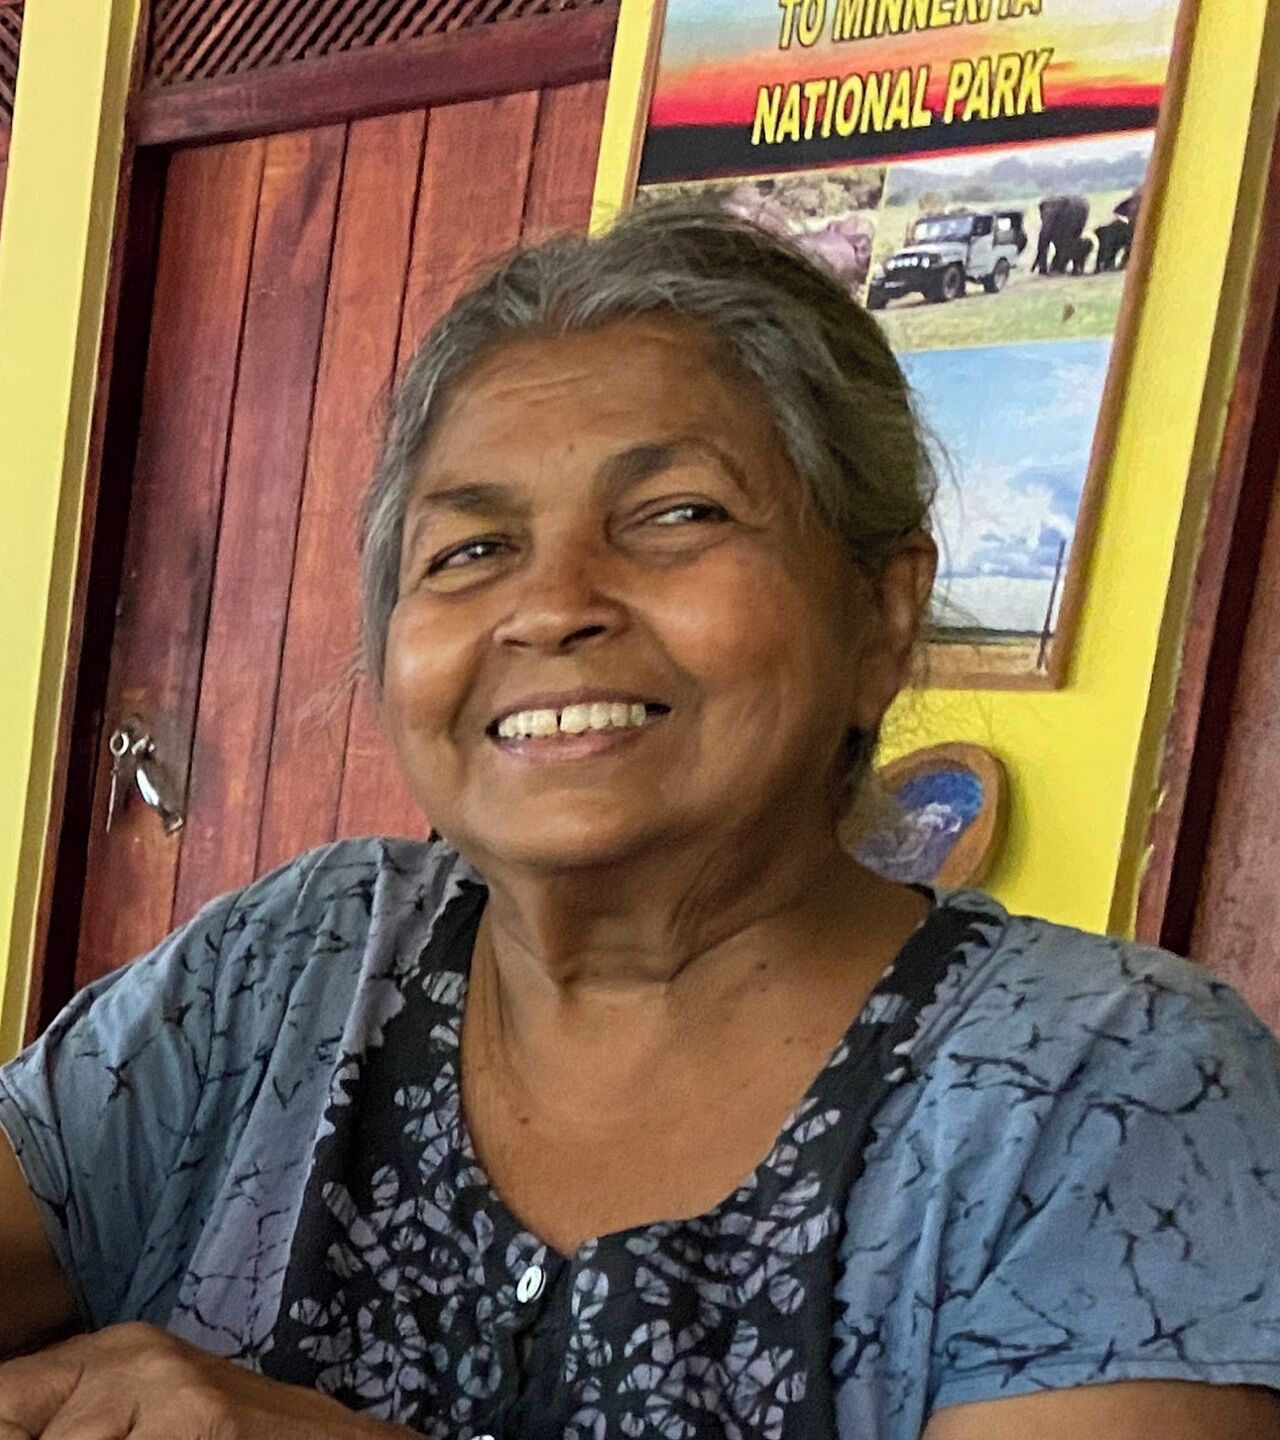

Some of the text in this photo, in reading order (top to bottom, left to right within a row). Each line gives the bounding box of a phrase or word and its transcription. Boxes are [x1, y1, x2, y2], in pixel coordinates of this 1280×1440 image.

[778, 0, 1042, 49] TO MINNE
[750, 48, 1054, 145] NATIONAL PARK
